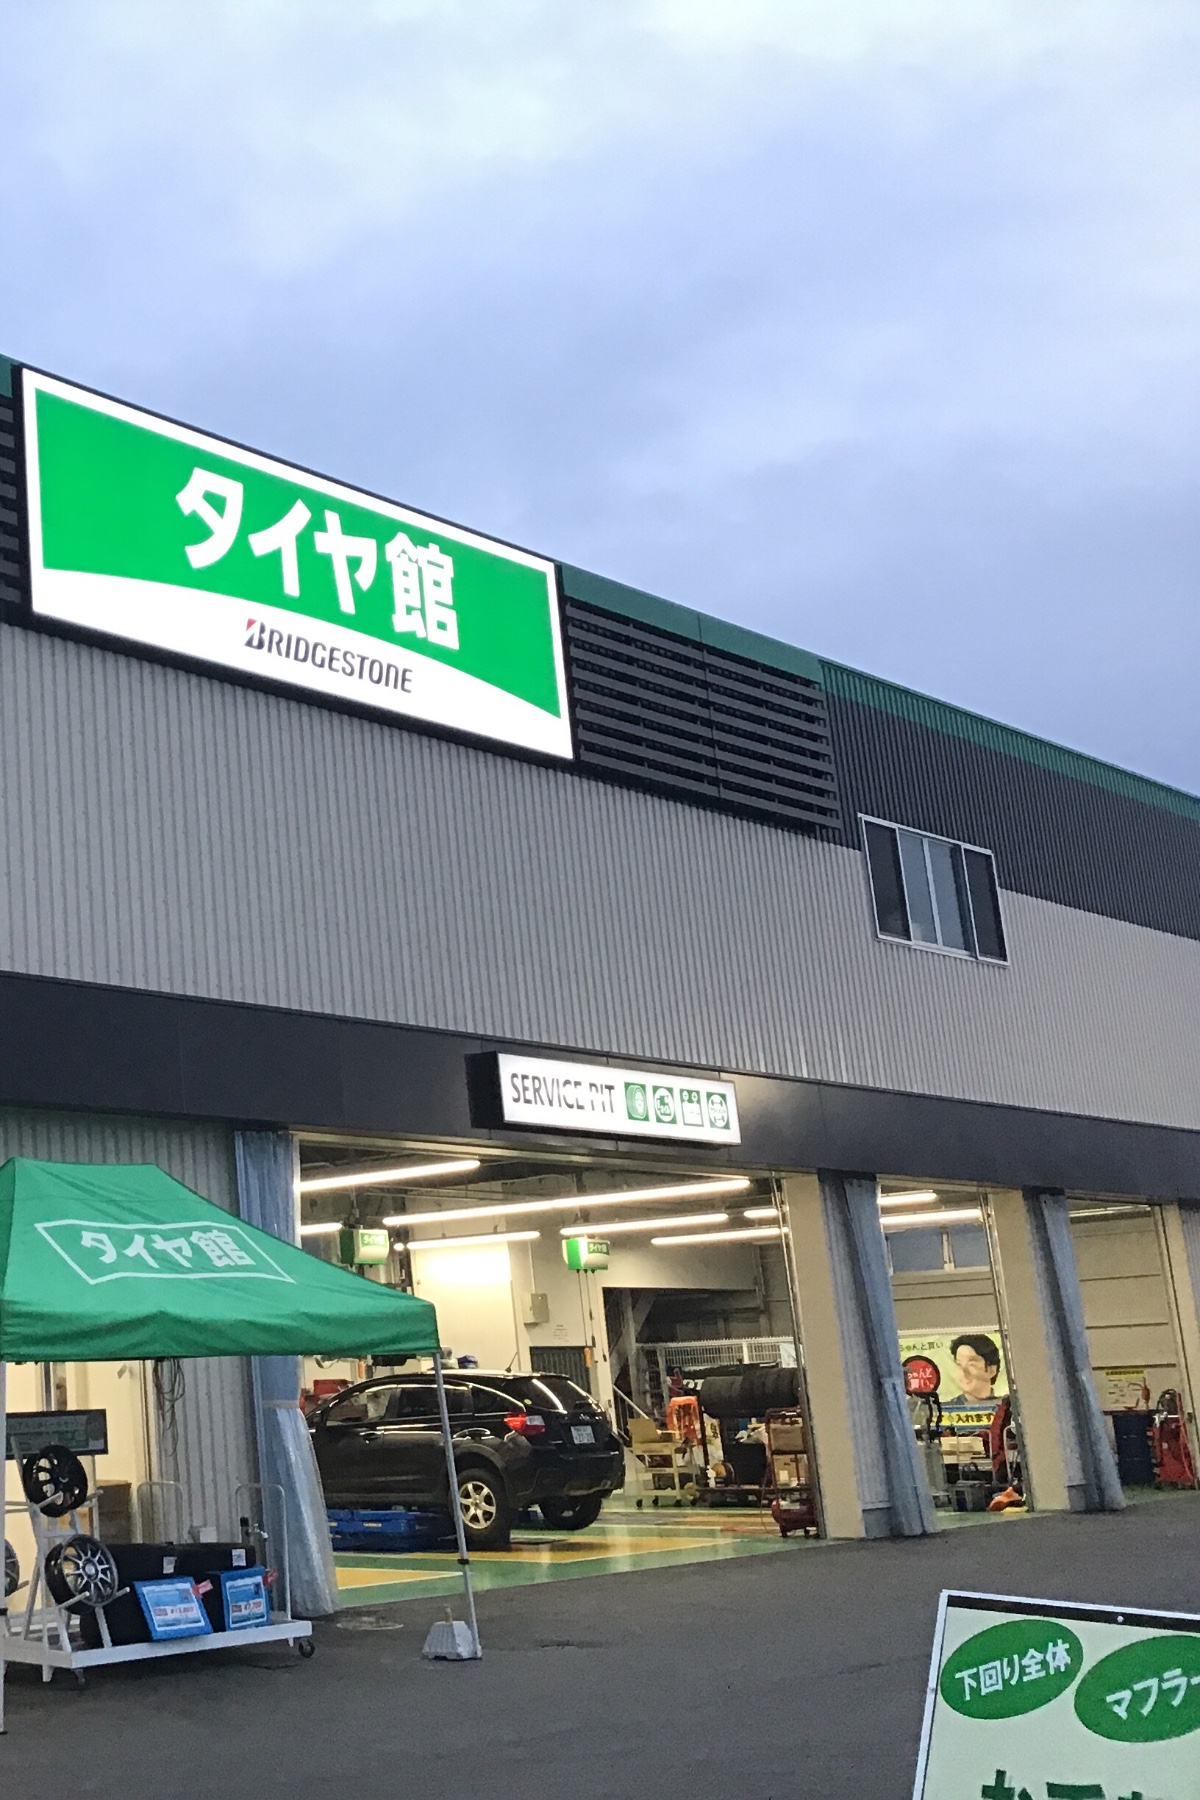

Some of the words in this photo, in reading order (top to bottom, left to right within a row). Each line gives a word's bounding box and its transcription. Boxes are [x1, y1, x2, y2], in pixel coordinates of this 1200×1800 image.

[175, 467, 460, 650] タイヤ館
[244, 618, 413, 694] BRIDGESTONE
[510, 1072, 586, 1110] SERVICE
[588, 1083, 616, 1114] PIT
[80, 1230, 256, 1268] タイヤ館
[954, 1638, 1072, 1701] 下回り全体
